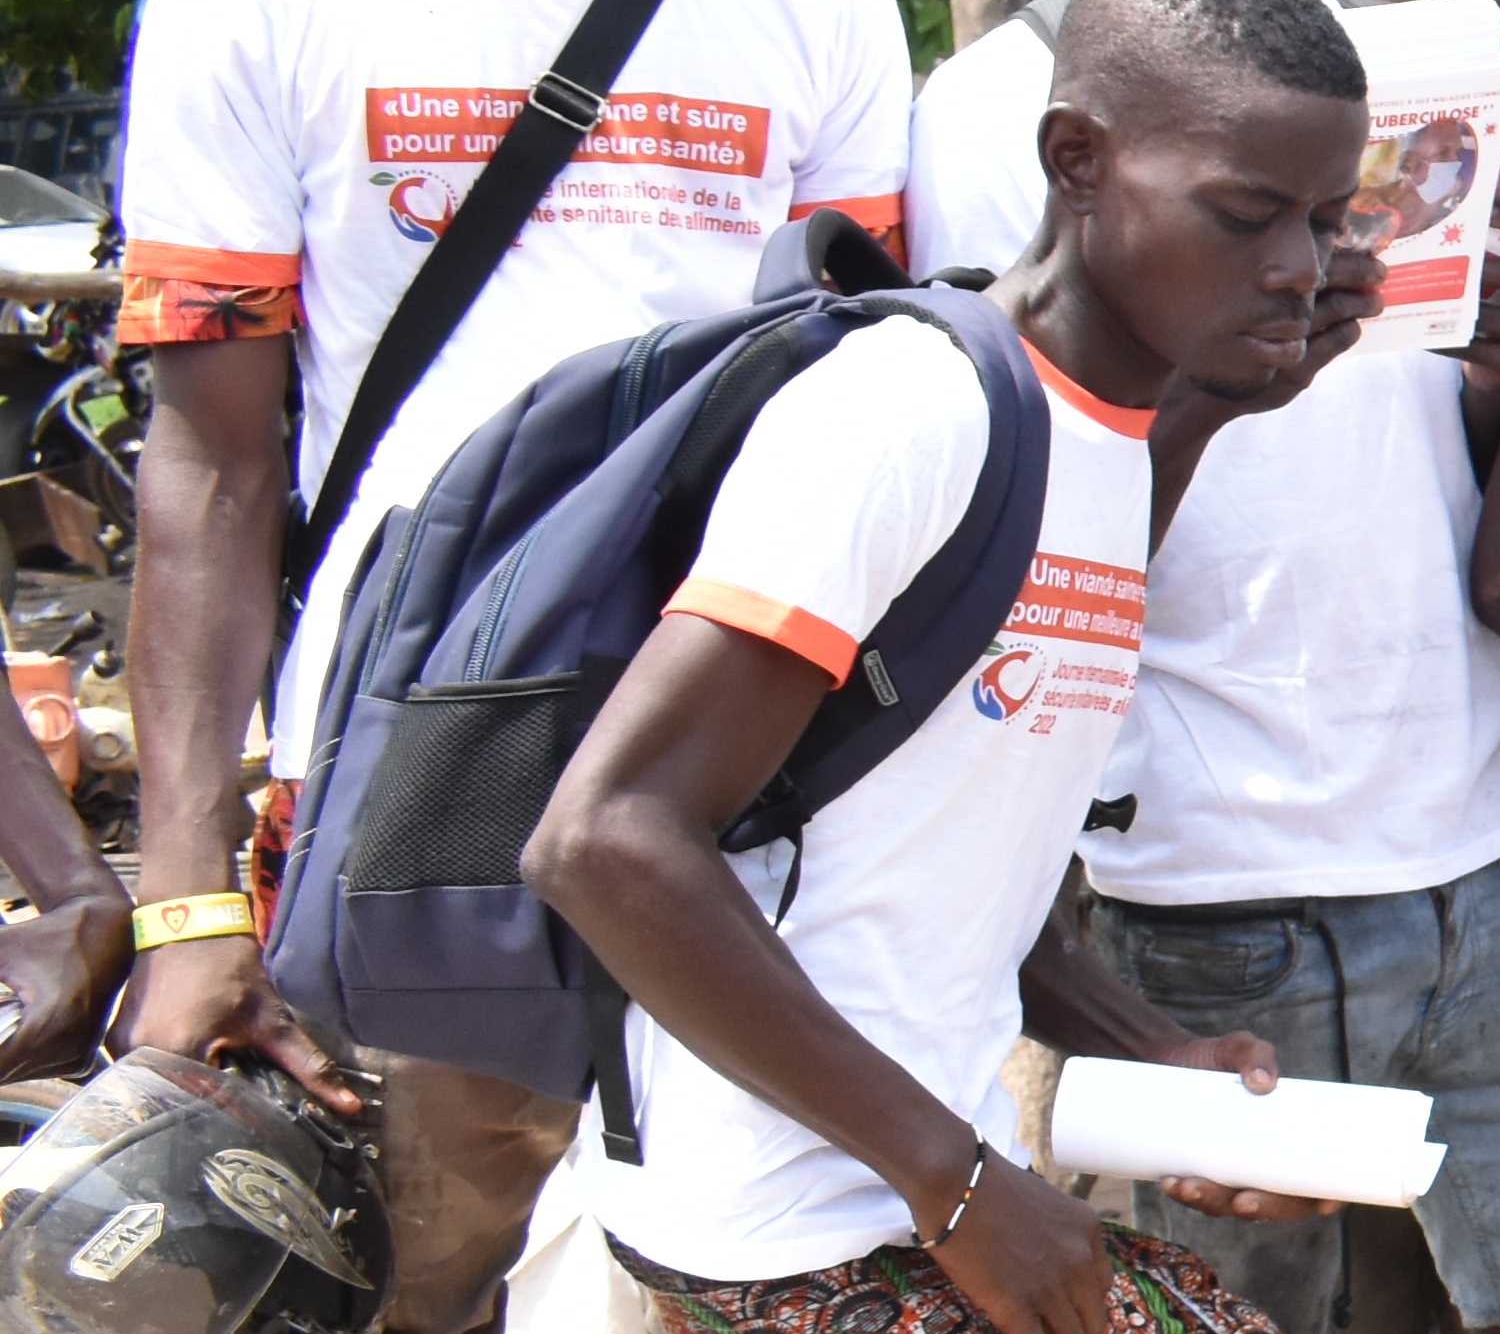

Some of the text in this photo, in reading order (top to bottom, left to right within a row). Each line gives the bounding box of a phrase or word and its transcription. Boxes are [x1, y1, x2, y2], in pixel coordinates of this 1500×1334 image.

[385, 93, 747, 133] «Une vian et sûre
[385, 134, 745, 166] pour un santé»
[693, 190, 717, 207] de
[724, 190, 741, 210] la
[562, 206, 652, 225] sanitaire
[685, 215, 761, 235] aliments
[1074, 567, 1116, 597] viande
[1006, 601, 1090, 630] pour une
